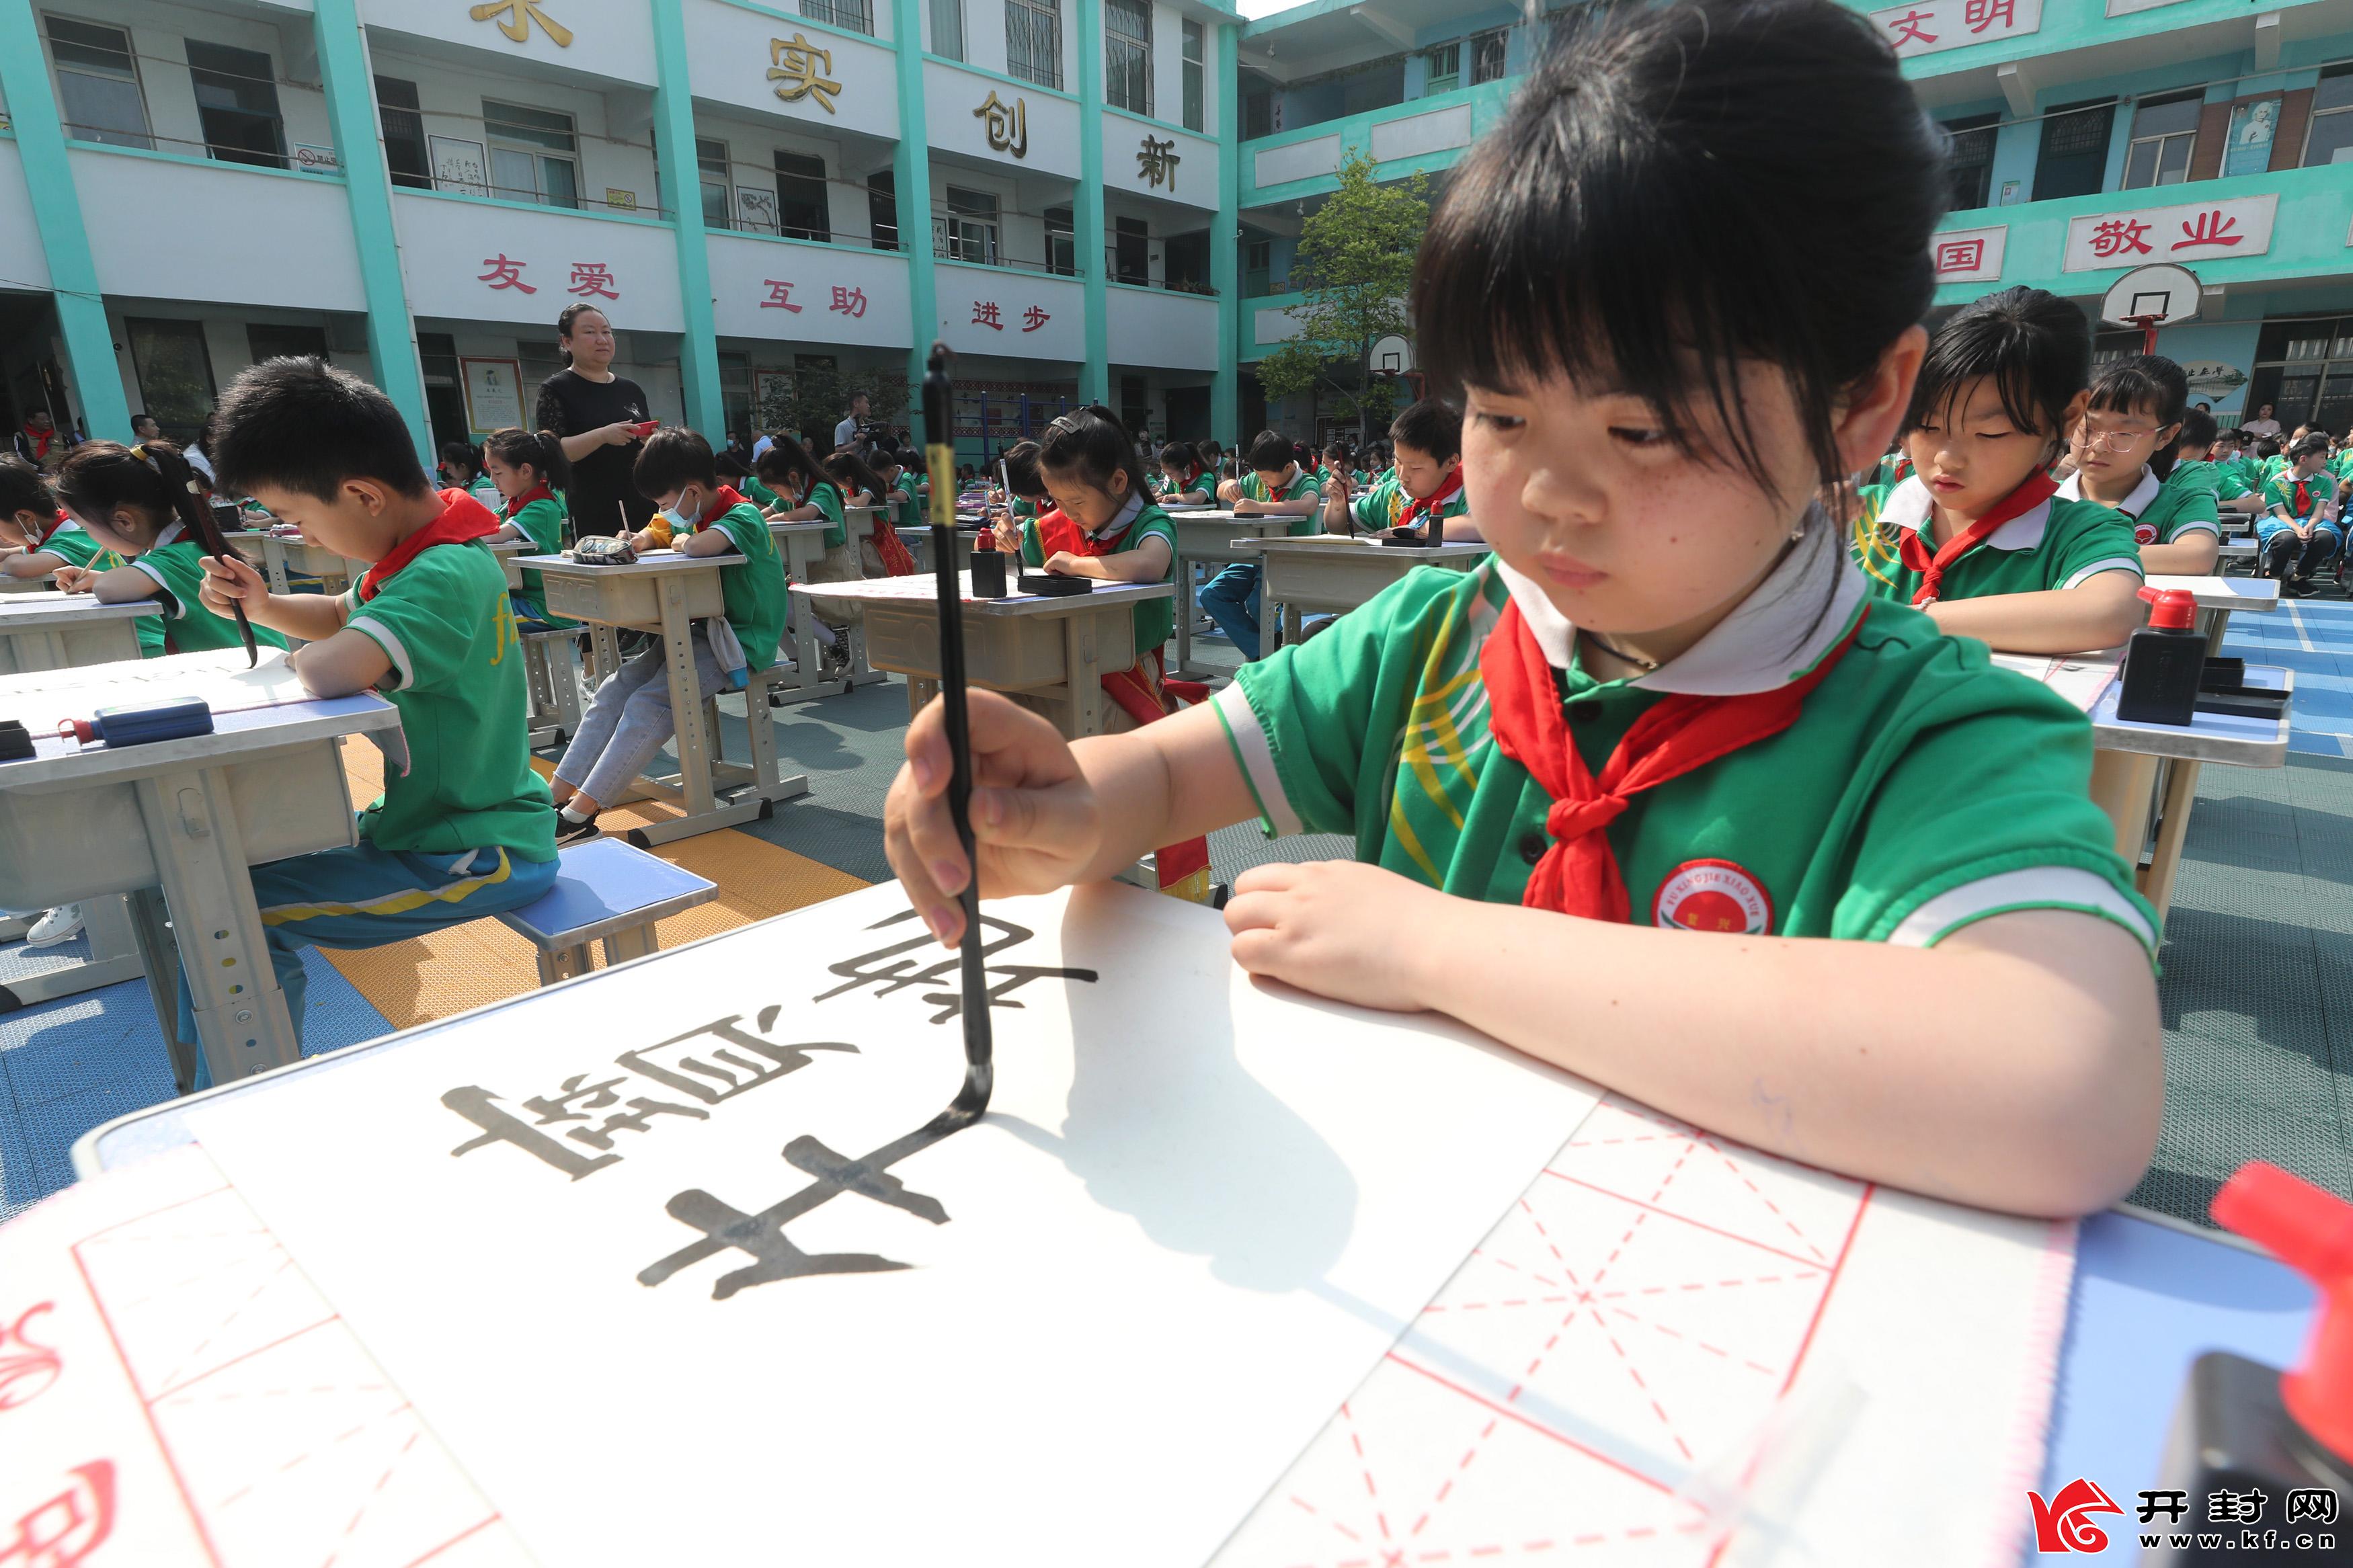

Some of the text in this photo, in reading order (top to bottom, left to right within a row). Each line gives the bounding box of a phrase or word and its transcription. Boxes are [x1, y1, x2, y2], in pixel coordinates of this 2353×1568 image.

[1888, 0, 2016, 48] 文明
[766, 32, 1181, 192] 实 创 新
[1937, 238, 1985, 275] 国
[2089, 210, 2244, 257] 敬业
[477, 253, 620, 300] 友爱
[760, 278, 868, 319] 互助
[971, 300, 1051, 333] 进步
